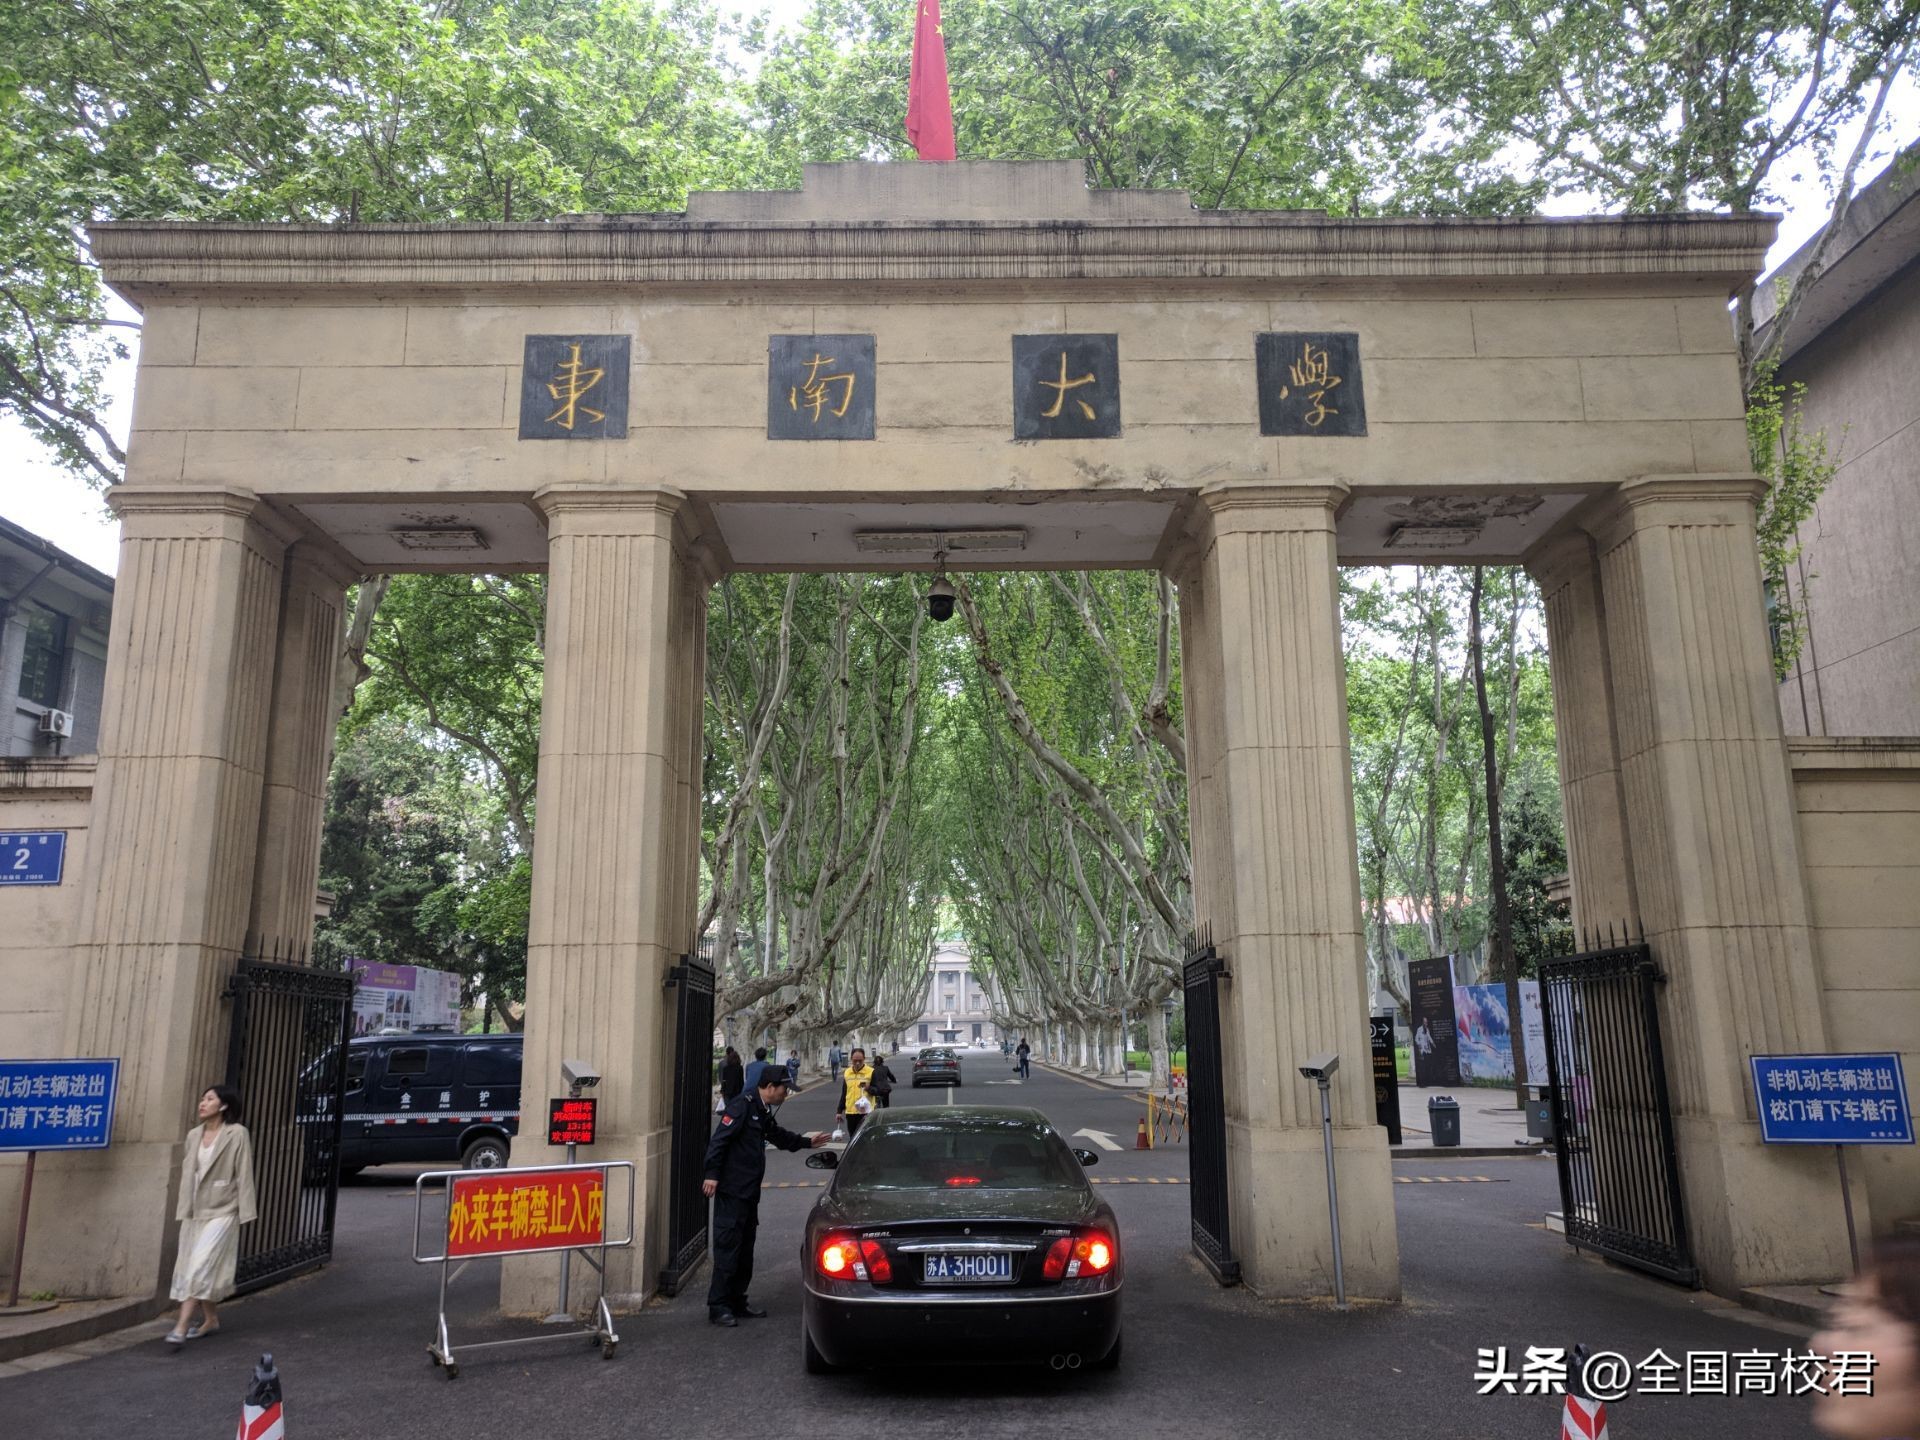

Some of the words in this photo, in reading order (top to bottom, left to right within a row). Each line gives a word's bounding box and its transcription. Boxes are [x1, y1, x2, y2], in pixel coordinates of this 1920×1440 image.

[13, 848, 30, 870] 2
[1767, 1068, 1895, 1091] 非机动车辆进出
[1770, 1098, 1898, 1121] 校门请下车推行
[449, 1183, 604, 1245] 外来车辆禁止入内
